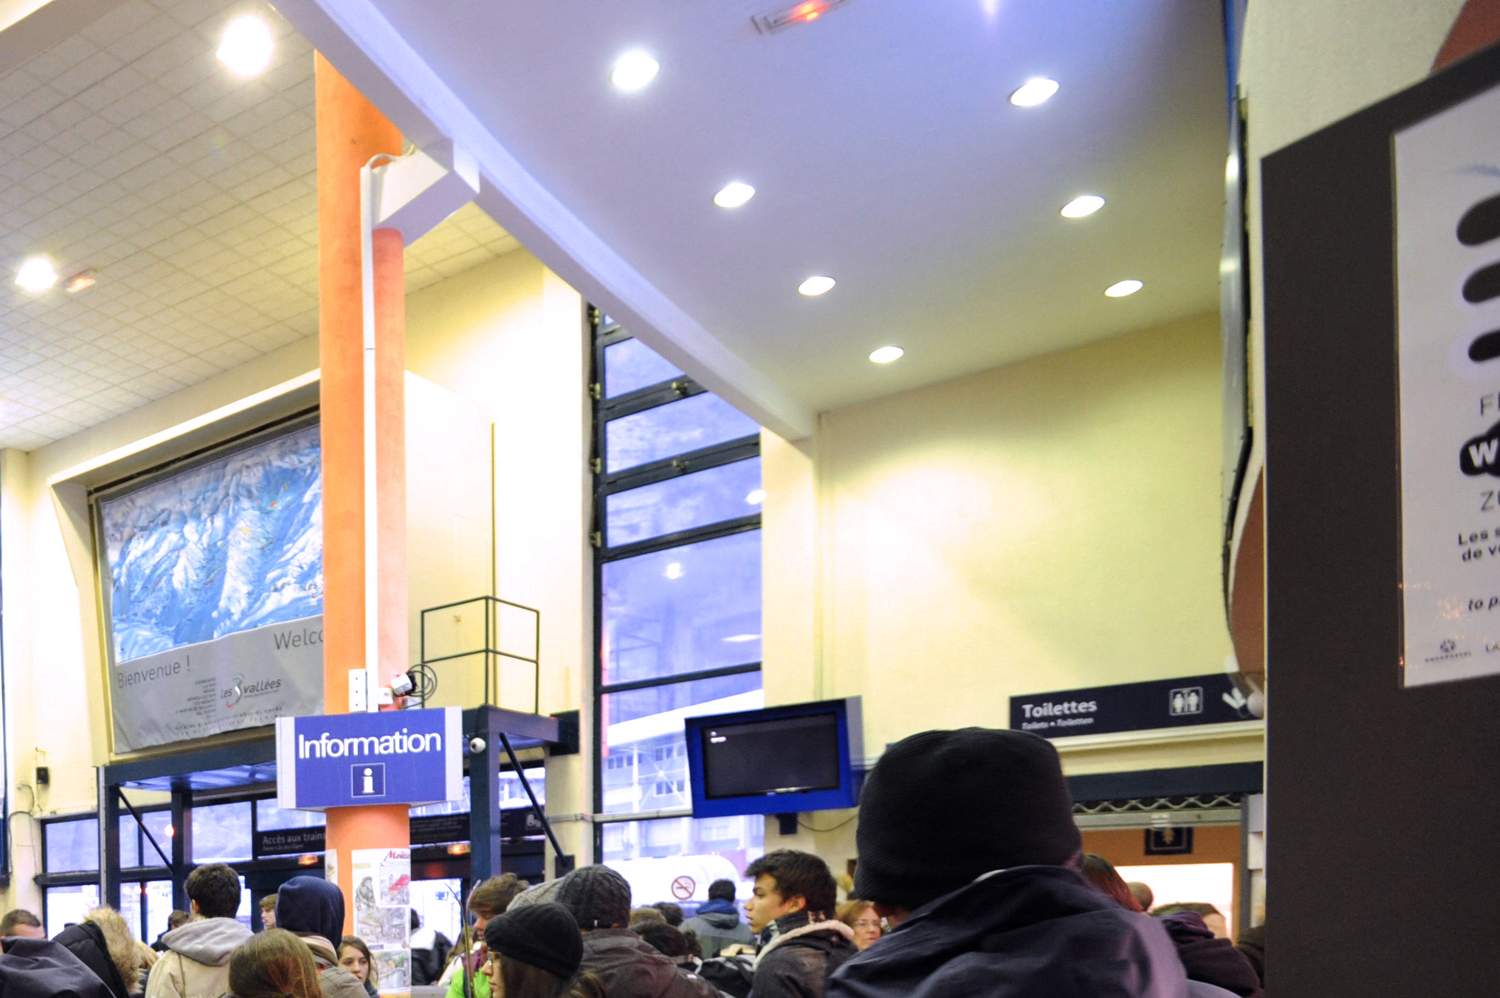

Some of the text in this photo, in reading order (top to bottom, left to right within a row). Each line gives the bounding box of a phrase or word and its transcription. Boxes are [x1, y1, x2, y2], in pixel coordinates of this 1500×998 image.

[1458, 529, 1489, 546] Les
[1462, 548, 1483, 562] de
[274, 627, 323, 651] Welc
[117, 660, 181, 690] Bienvenue
[243, 679, 282, 695] vallées
[1022, 701, 1098, 718] Toilettes
[298, 727, 442, 759] Information
[262, 834, 286, 845] Accès
[287, 835, 301, 843] aux
